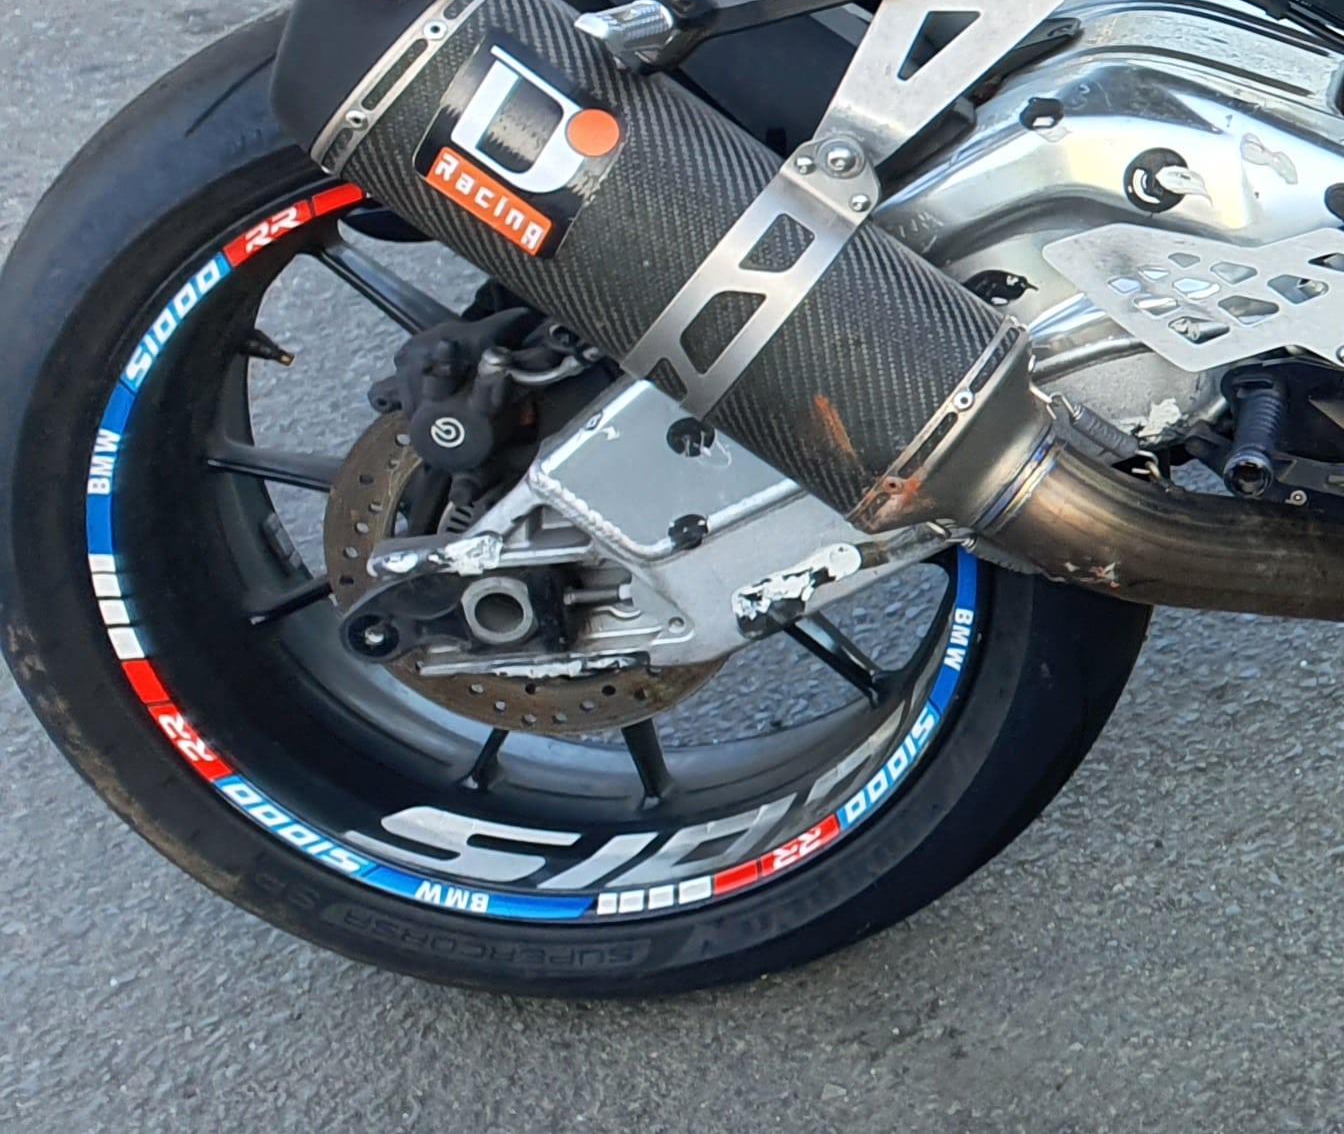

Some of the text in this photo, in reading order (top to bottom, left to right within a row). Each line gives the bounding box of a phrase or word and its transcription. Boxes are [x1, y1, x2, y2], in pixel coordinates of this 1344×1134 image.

[434, 152, 545, 251] Racing
[87, 428, 121, 495] BMW
[124, 258, 221, 384] S1000
[245, 206, 300, 253] RR
[158, 713, 490, 914] BMW S1000 RR
[772, 607, 975, 871] BMW S1000 RR
